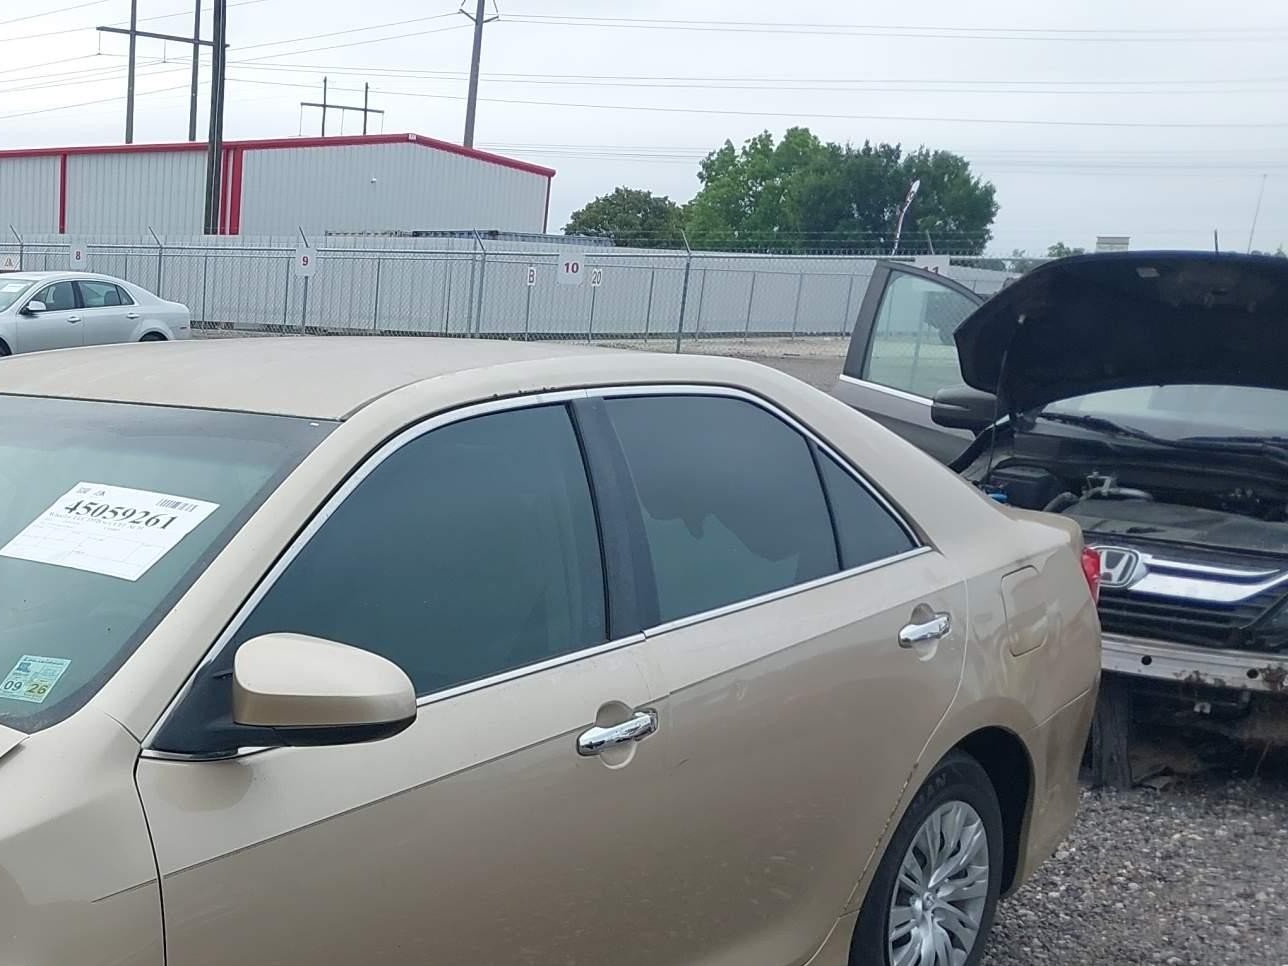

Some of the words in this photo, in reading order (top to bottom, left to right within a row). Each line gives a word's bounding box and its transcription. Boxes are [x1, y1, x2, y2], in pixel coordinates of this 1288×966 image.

[75, 251, 81, 260] 8
[302, 256, 309, 266] 9
[564, 262, 580, 274] 10
[528, 269, 535, 284] B
[592, 271, 602, 285] 20
[64, 499, 179, 530] 45059261
[3, 680, 23, 692] 09
[27, 683, 49, 695] 26
